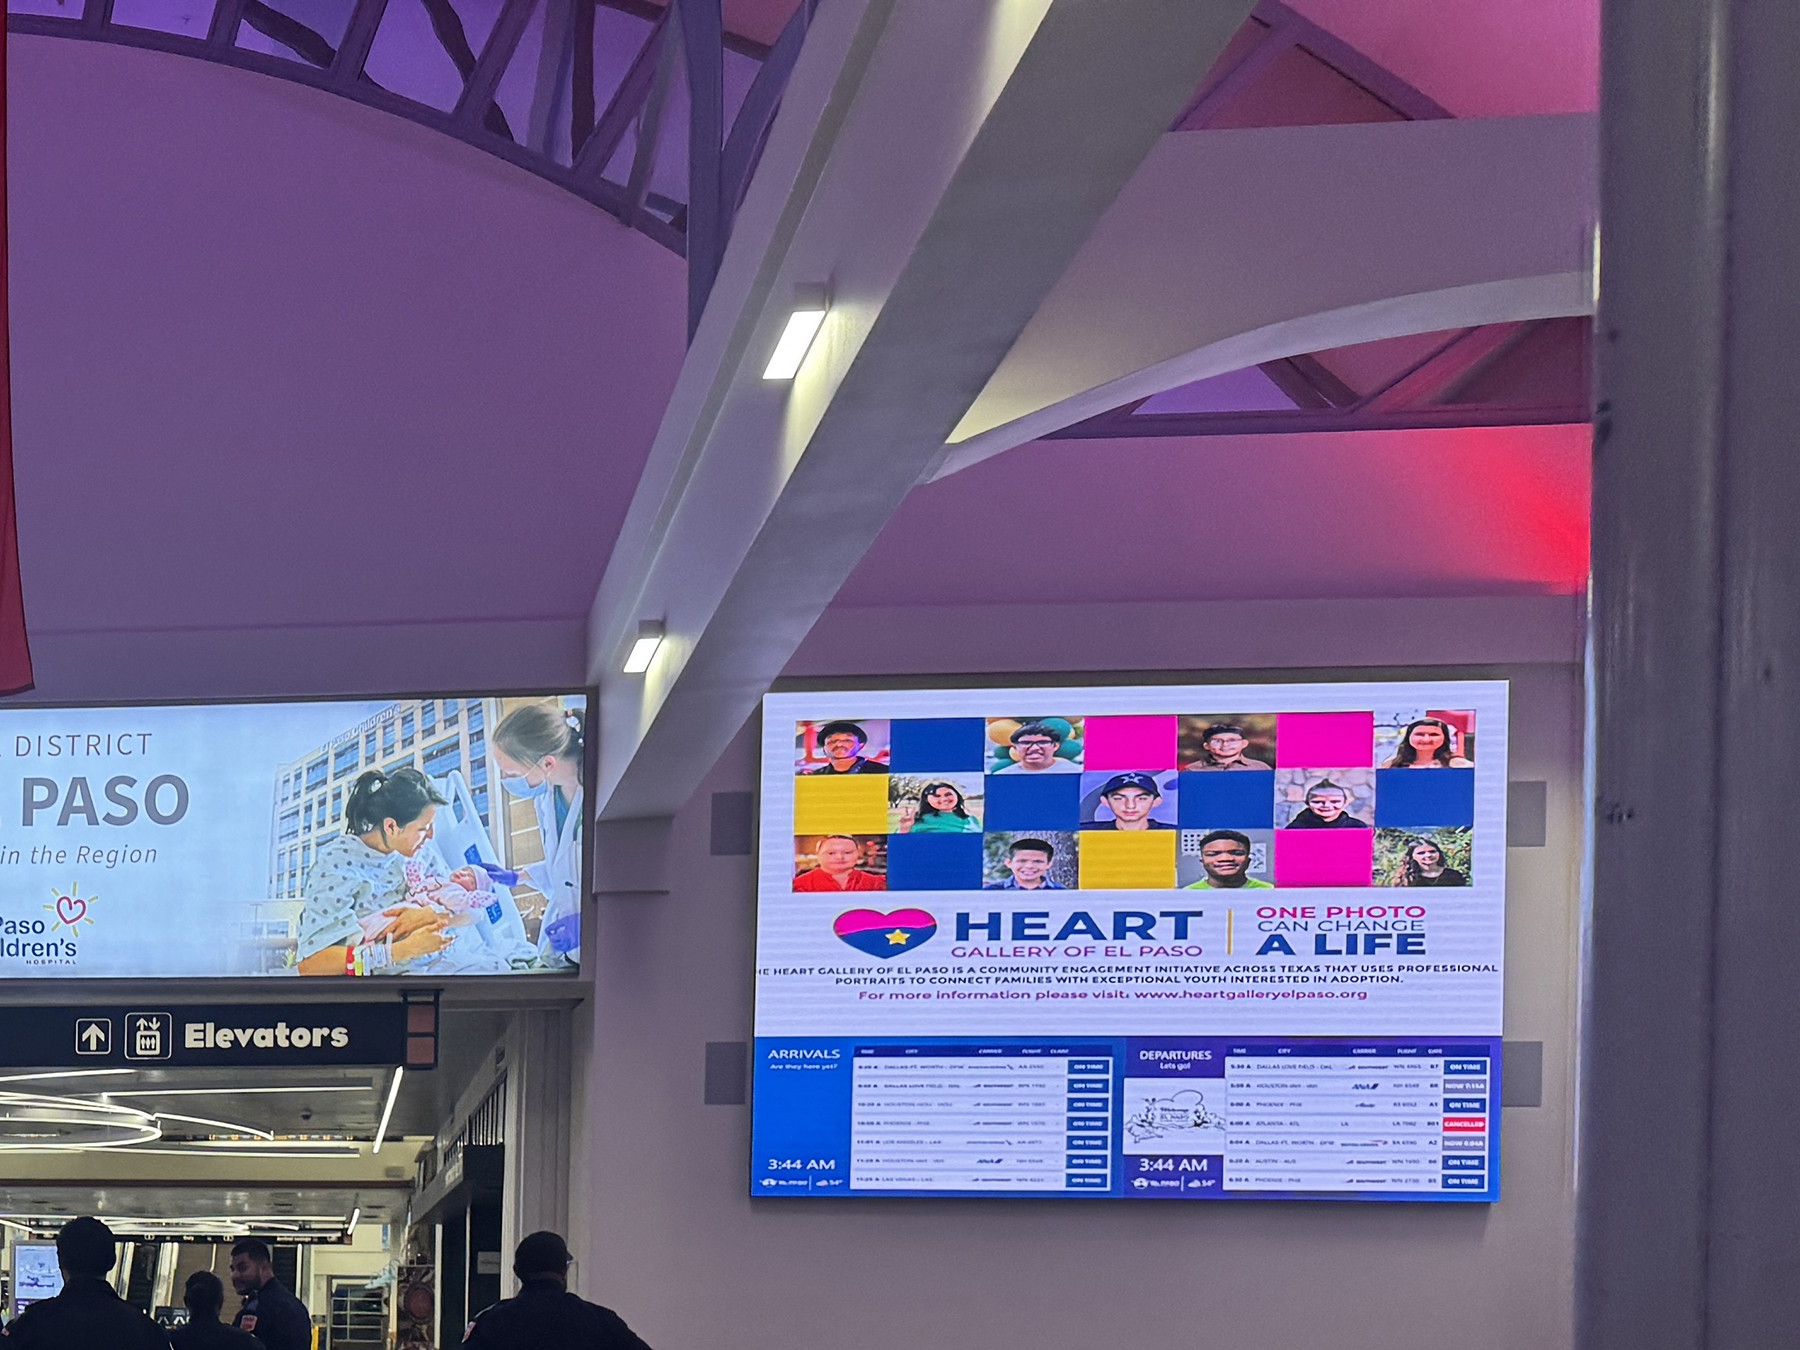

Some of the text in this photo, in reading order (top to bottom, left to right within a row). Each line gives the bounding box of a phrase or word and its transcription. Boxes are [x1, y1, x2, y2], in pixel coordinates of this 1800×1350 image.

[15, 733, 152, 757] DISTRICT
[22, 774, 189, 827] PASO
[0, 845, 20, 865] in
[31, 845, 67, 865] the
[76, 845, 158, 869] Region
[1256, 905, 1426, 919] ONE PHOTO
[955, 910, 1203, 941] HEART
[1257, 919, 1425, 932] CAN CHANGE
[1255, 933, 1426, 955] A LIFE
[951, 945, 1203, 958] GALLERY OF EL PASO
[773, 967, 814, 975] HEART
[818, 967, 873, 975] GALLERY
[877, 967, 894, 975] OF
[898, 967, 912, 975] EL
[915, 967, 948, 975] PASO
[952, 966, 964, 974] IS
[967, 966, 976, 974] A
[980, 966, 1059, 974] COMMUNITY
[1062, 966, 1151, 974] ENGAGEMENT
[1155, 965, 1220, 974] INITIATIVE
[1224, 965, 1276, 974] ACROSS
[1280, 965, 1321, 974] TEXAS
[1325, 965, 1357, 974] THAT
[1361, 965, 1394, 974] USES
[1397, 964, 1499, 973] PROFESSIONAL
[835, 975, 1404, 985] PORTRAITS TO CONNECT FAMILIES WITH EXCEPTIONAL YOUTH INTERESTED IN ADOPTION.
[859, 991, 886, 1000] For
[889, 992, 932, 1000] more
[936, 990, 1031, 1000] information
[1036, 990, 1089, 1001] please
[1134, 989, 1368, 1001] www.heartgalleryelpaso.org
[185, 1022, 349, 1049] Elevators
[767, 1049, 841, 1059] ARRIVALS
[1139, 1050, 1213, 1060] DEPARTURES
[767, 1159, 836, 1170] 3:44 AM
[1139, 1158, 1208, 1172] 3:44 AM
